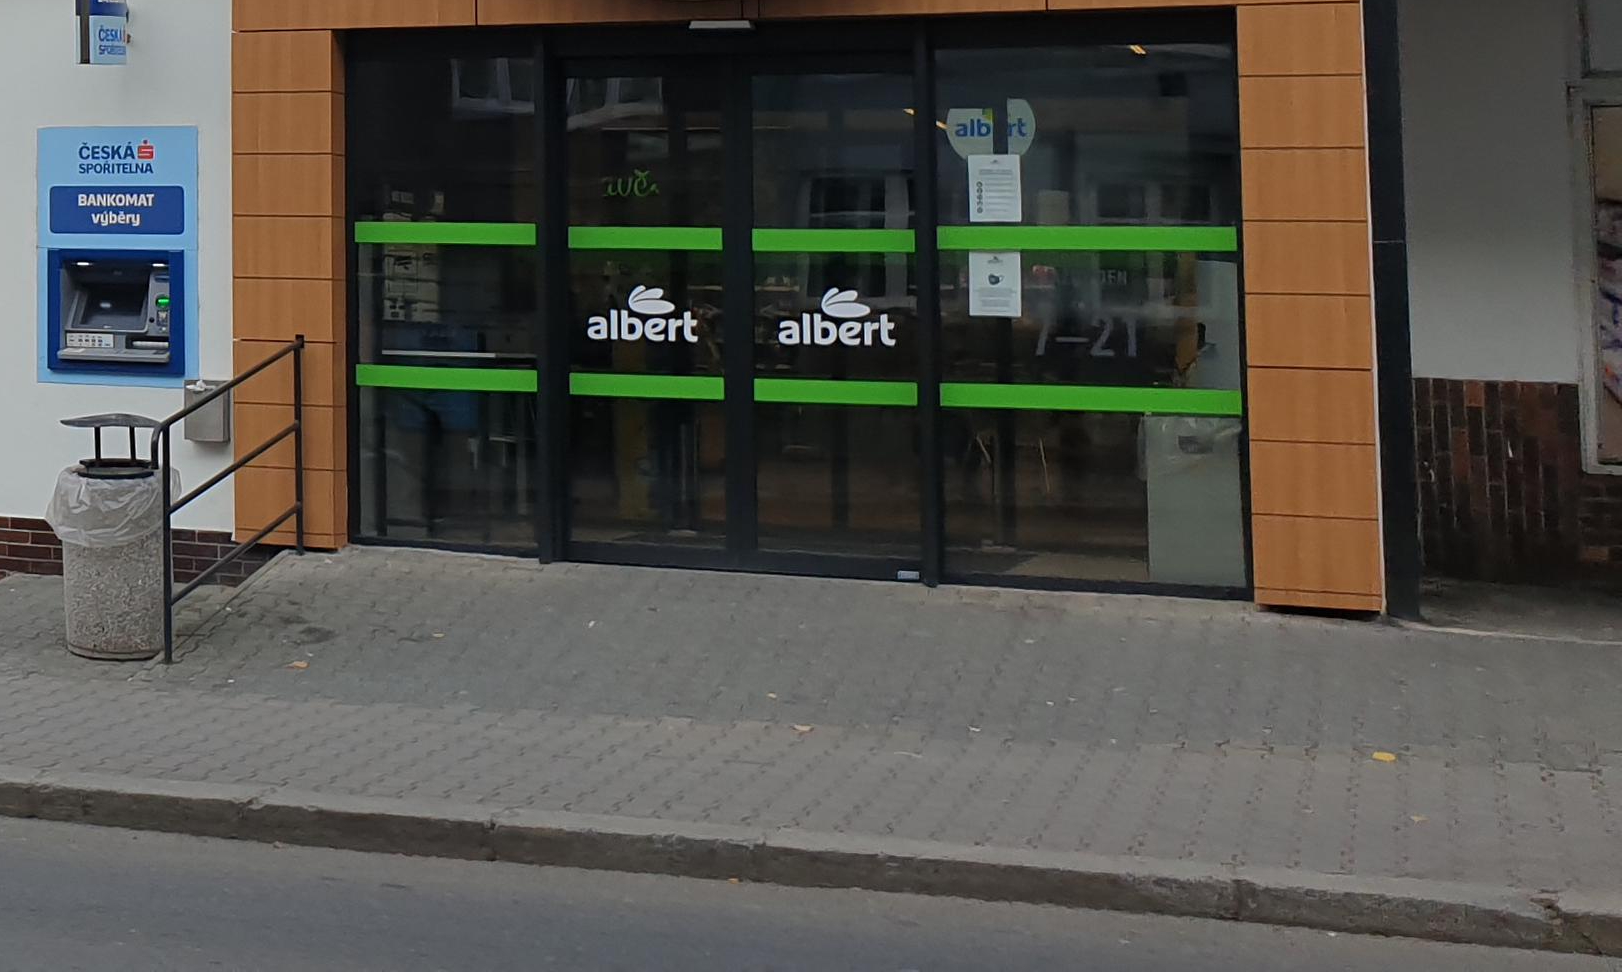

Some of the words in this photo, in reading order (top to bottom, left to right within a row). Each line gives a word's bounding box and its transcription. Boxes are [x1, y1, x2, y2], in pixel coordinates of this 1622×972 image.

[955, 118, 1027, 137] albrt
[78, 141, 135, 160] ČESKÁ
[78, 160, 154, 174] SPOŘITELNA
[78, 194, 154, 207] BANKOMAT
[91, 211, 141, 226] výběry
[587, 309, 699, 343] albert
[778, 312, 896, 346] albert
